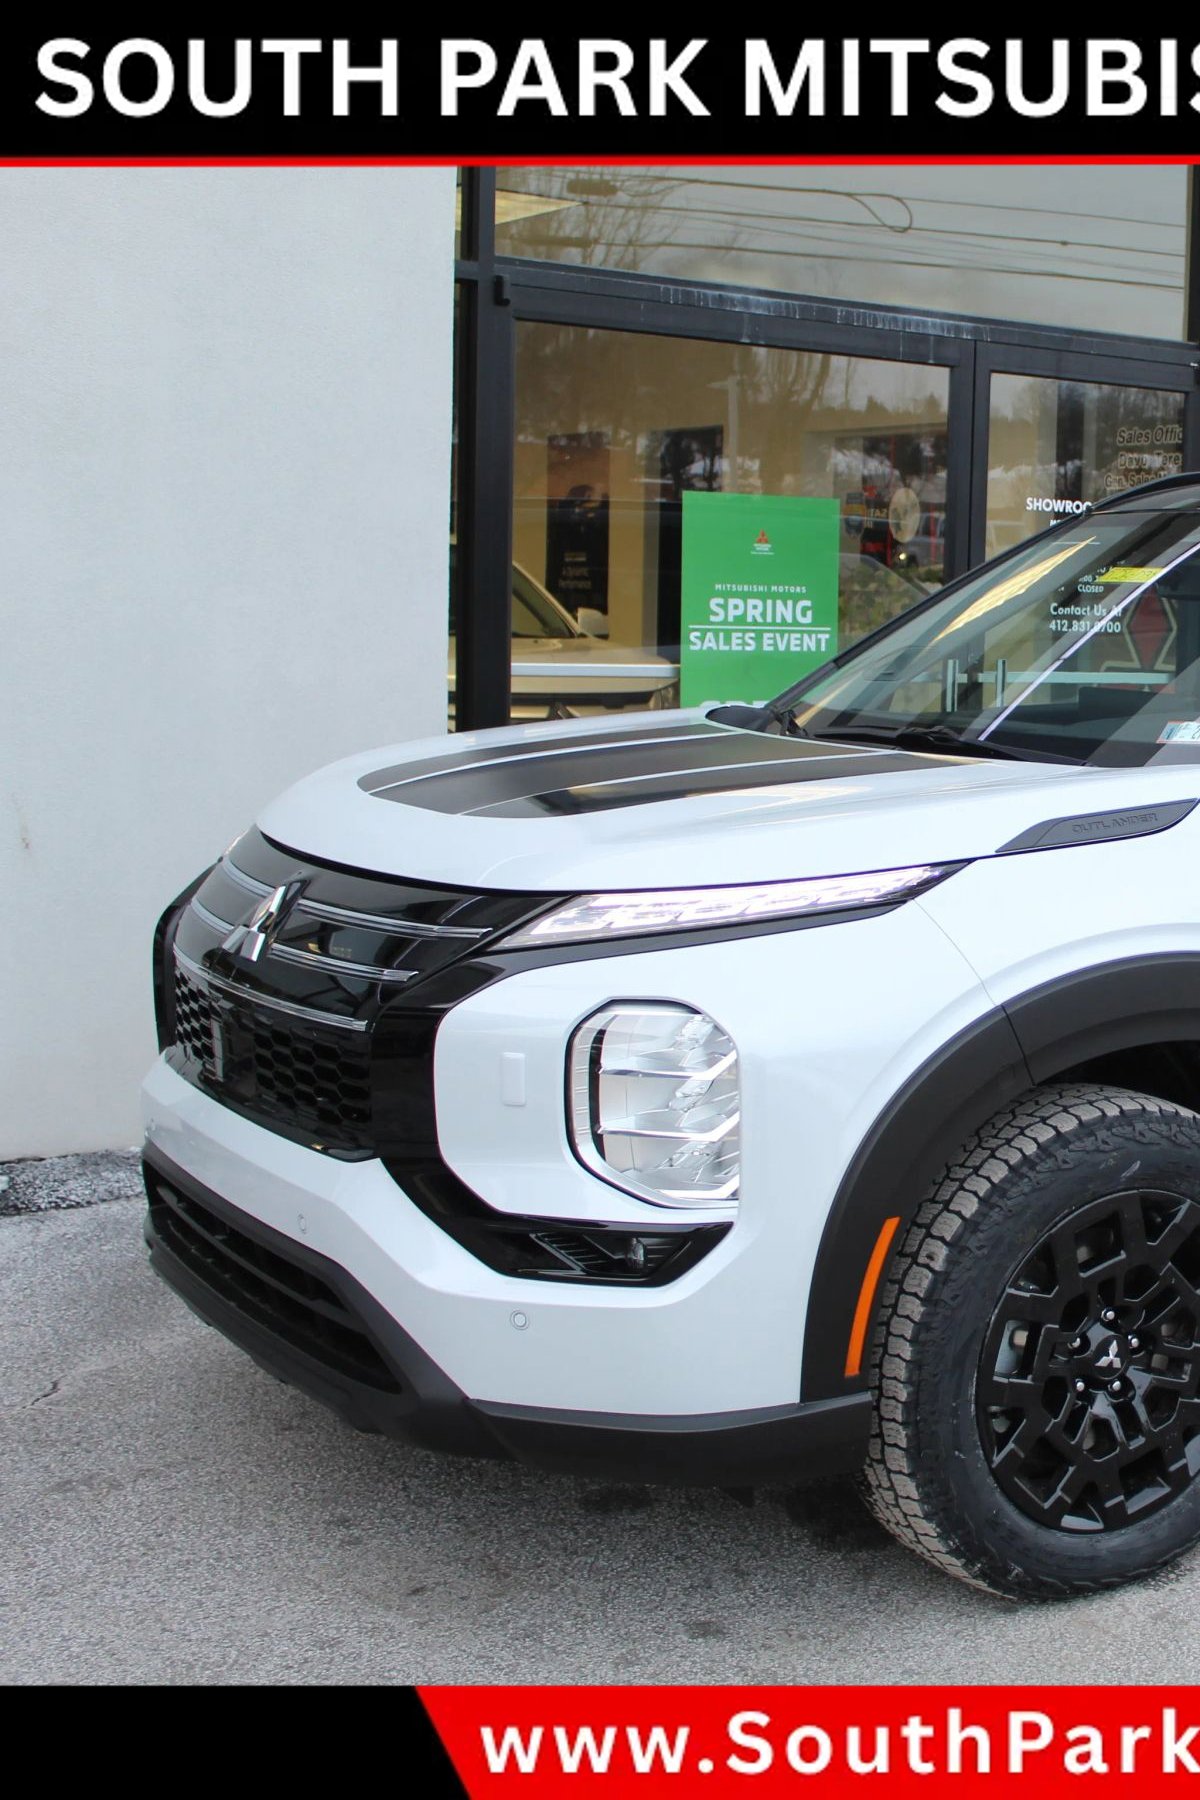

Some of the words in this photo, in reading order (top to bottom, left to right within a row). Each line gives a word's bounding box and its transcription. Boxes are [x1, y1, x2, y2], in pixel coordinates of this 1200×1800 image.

[1116, 429, 1150, 445] Sales
[1152, 425, 1183, 443] Offic
[715, 583, 768, 592] MITSUBISHI
[771, 585, 807, 593] MOTORS
[1077, 584, 1104, 593] CLOSED
[709, 597, 813, 624] SPRING
[1050, 602, 1090, 616] Contact
[1093, 603, 1107, 616] Us
[689, 631, 756, 651] SALES
[762, 632, 830, 652] EVENT
[1072, 812, 1158, 834] OUTLANDER
